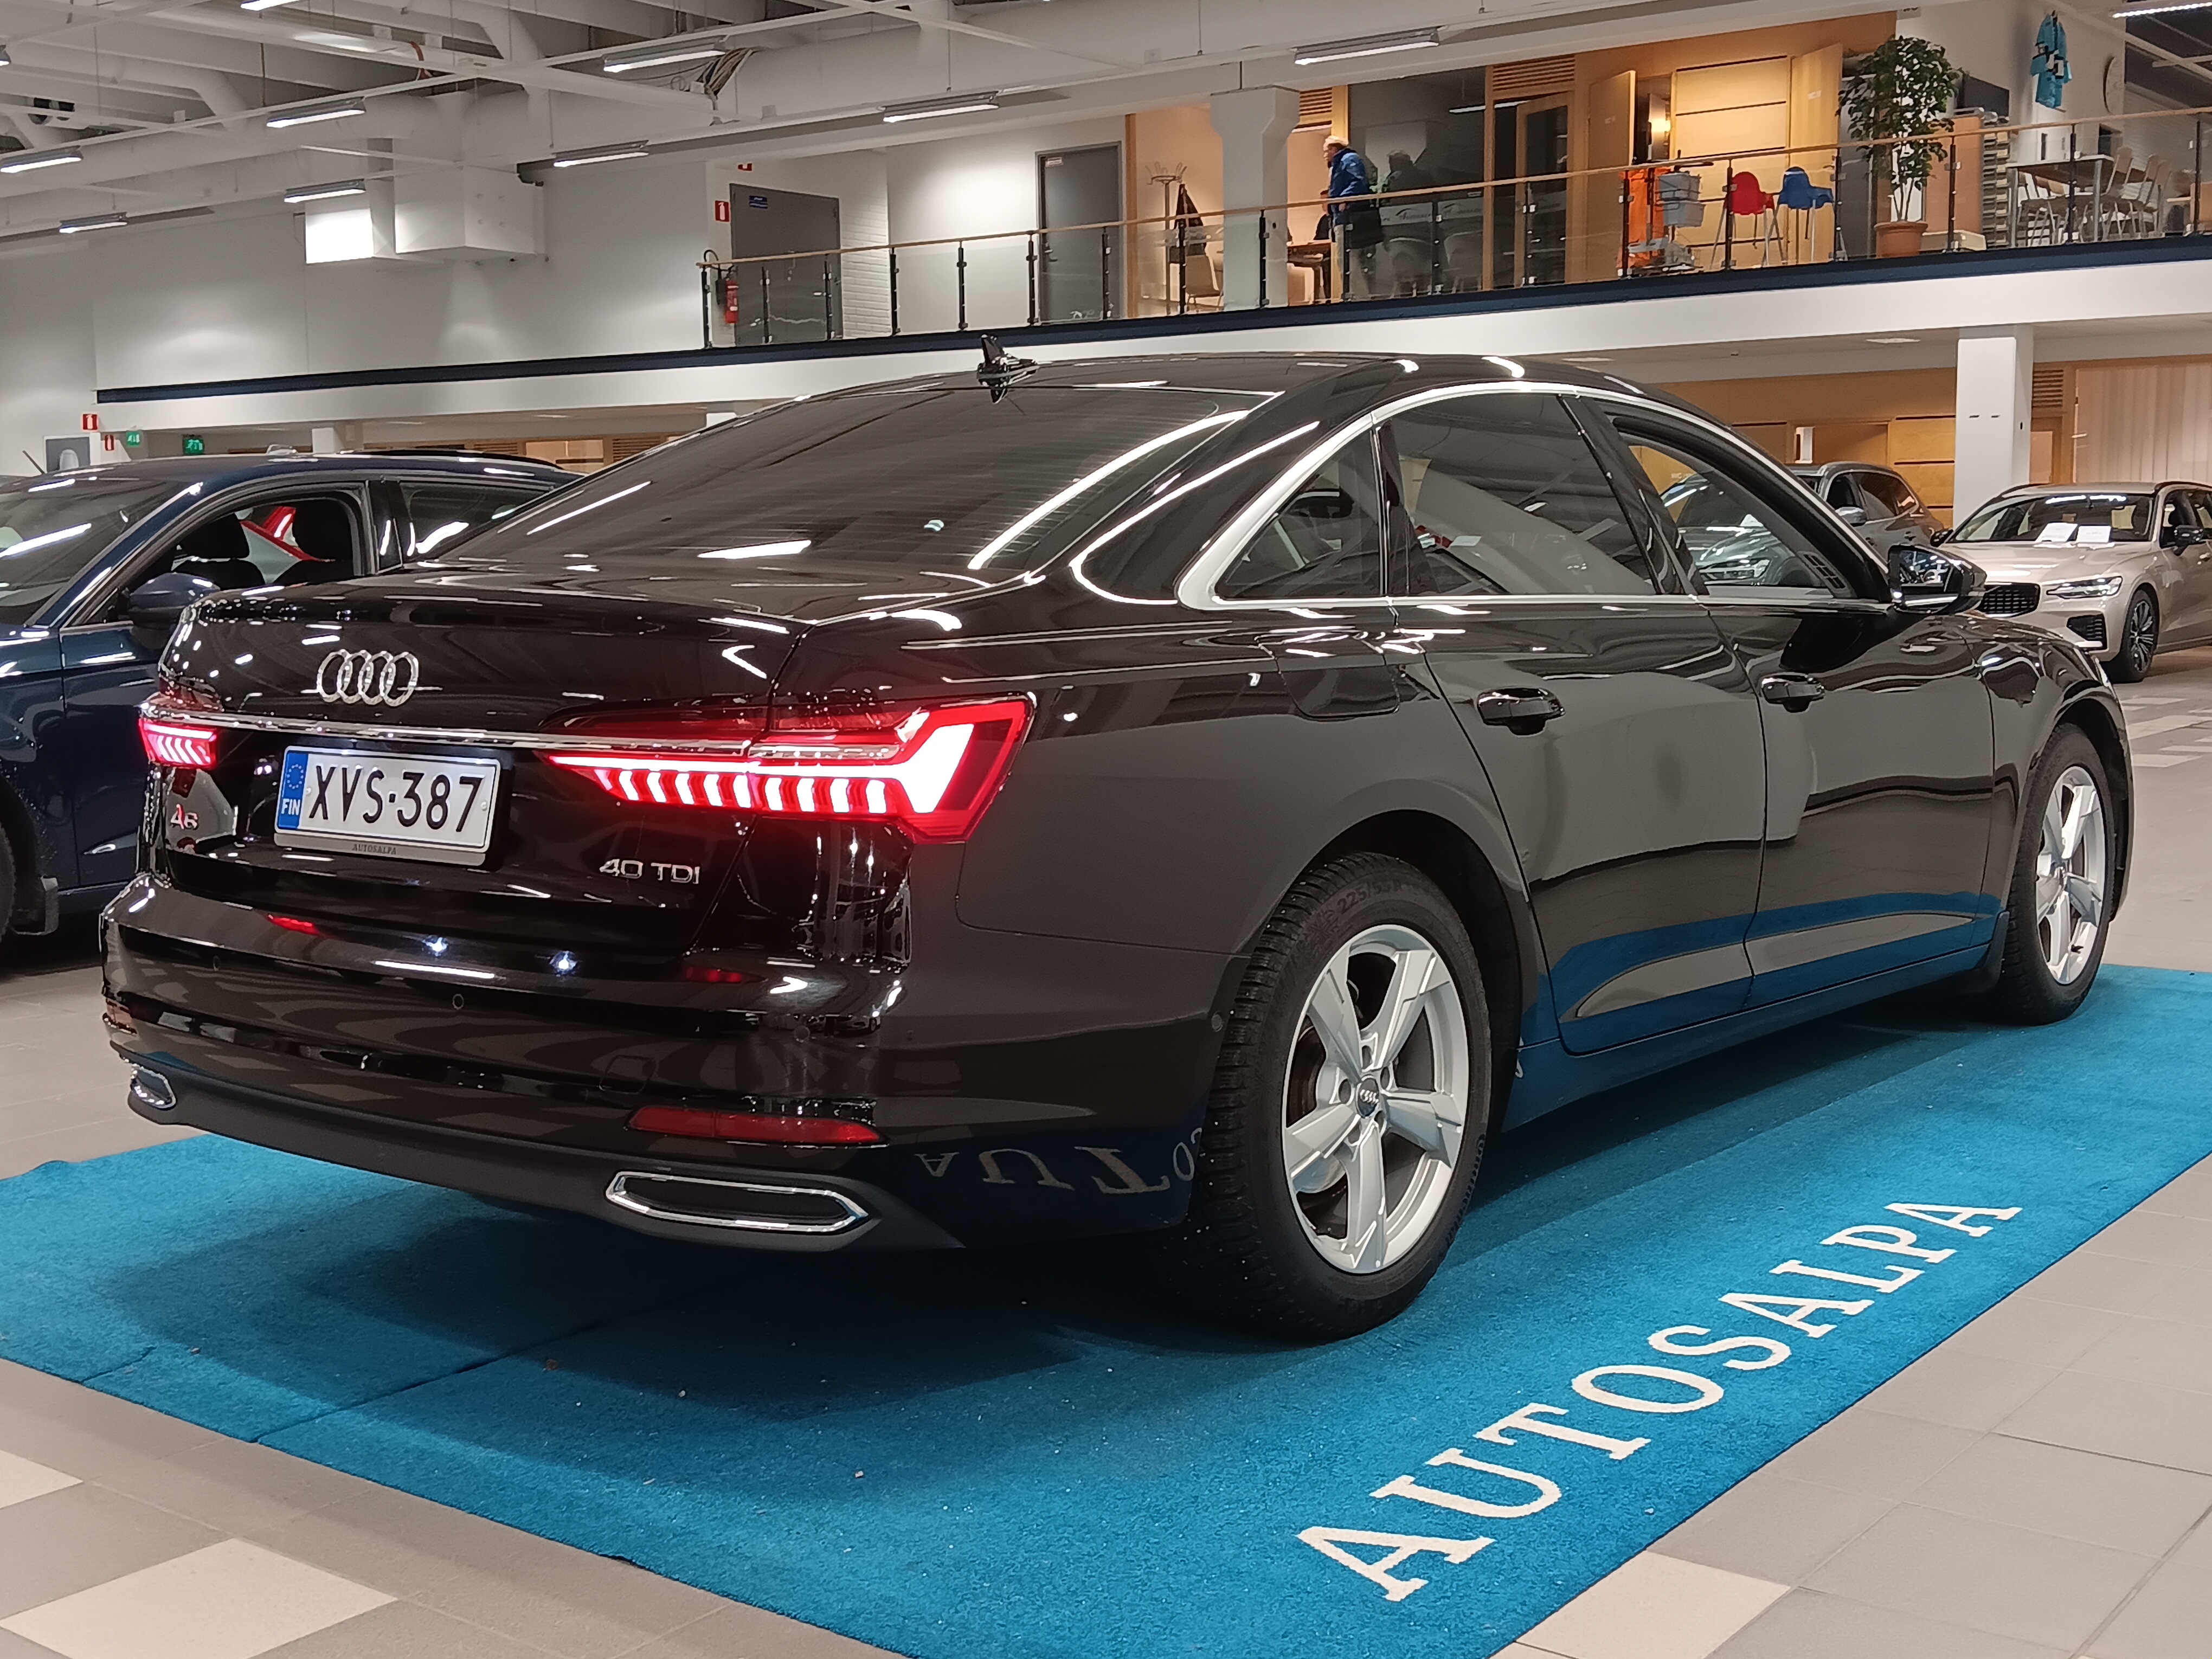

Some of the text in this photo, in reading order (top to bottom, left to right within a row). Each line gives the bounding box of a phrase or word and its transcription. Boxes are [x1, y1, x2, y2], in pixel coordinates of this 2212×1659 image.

[281, 798, 301, 816] FIN
[308, 765, 484, 833] XVS-387
[351, 844, 396, 855] AUTOSALPA
[599, 858, 700, 884] 40 TDI
[1296, 1201, 2023, 1602] AUTOSALPA
